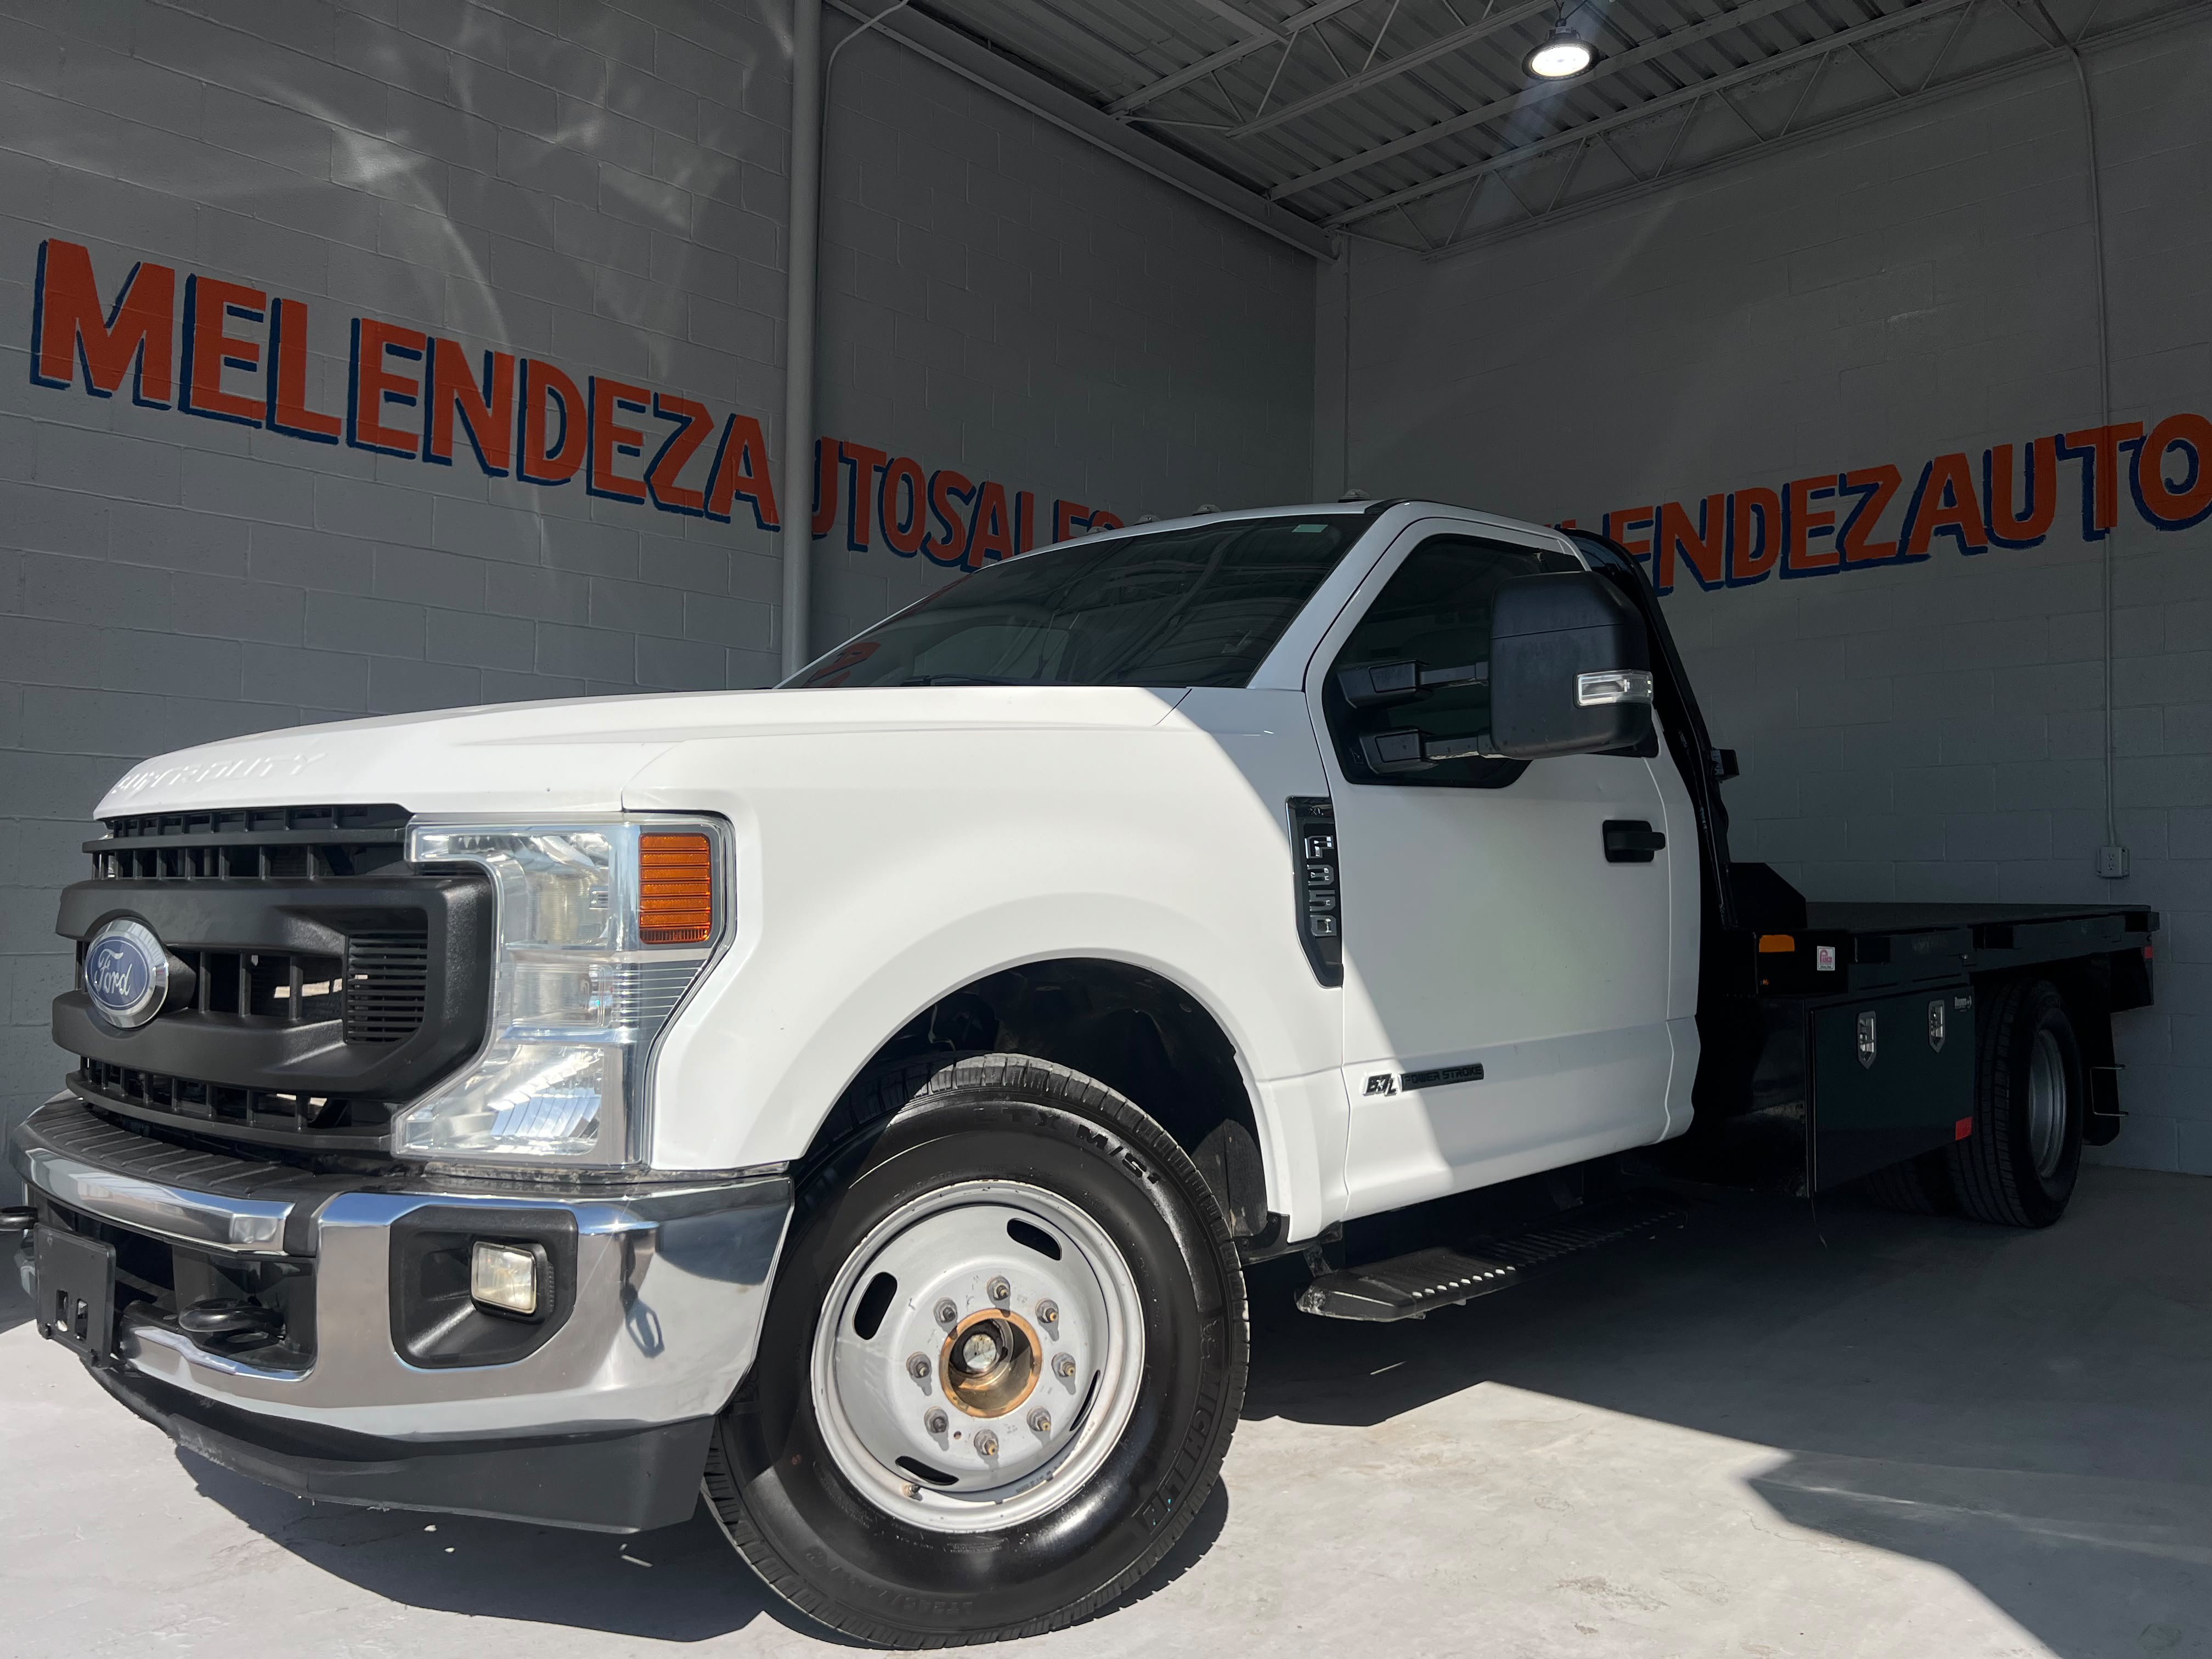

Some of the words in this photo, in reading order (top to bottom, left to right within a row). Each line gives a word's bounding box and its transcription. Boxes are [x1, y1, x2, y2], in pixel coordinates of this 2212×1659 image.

[94, 948, 132, 996] Ford
[1403, 1072, 1441, 1086] POWER
[1442, 1065, 1482, 1080] STROKE
[974, 1107, 1062, 1130] LTX
